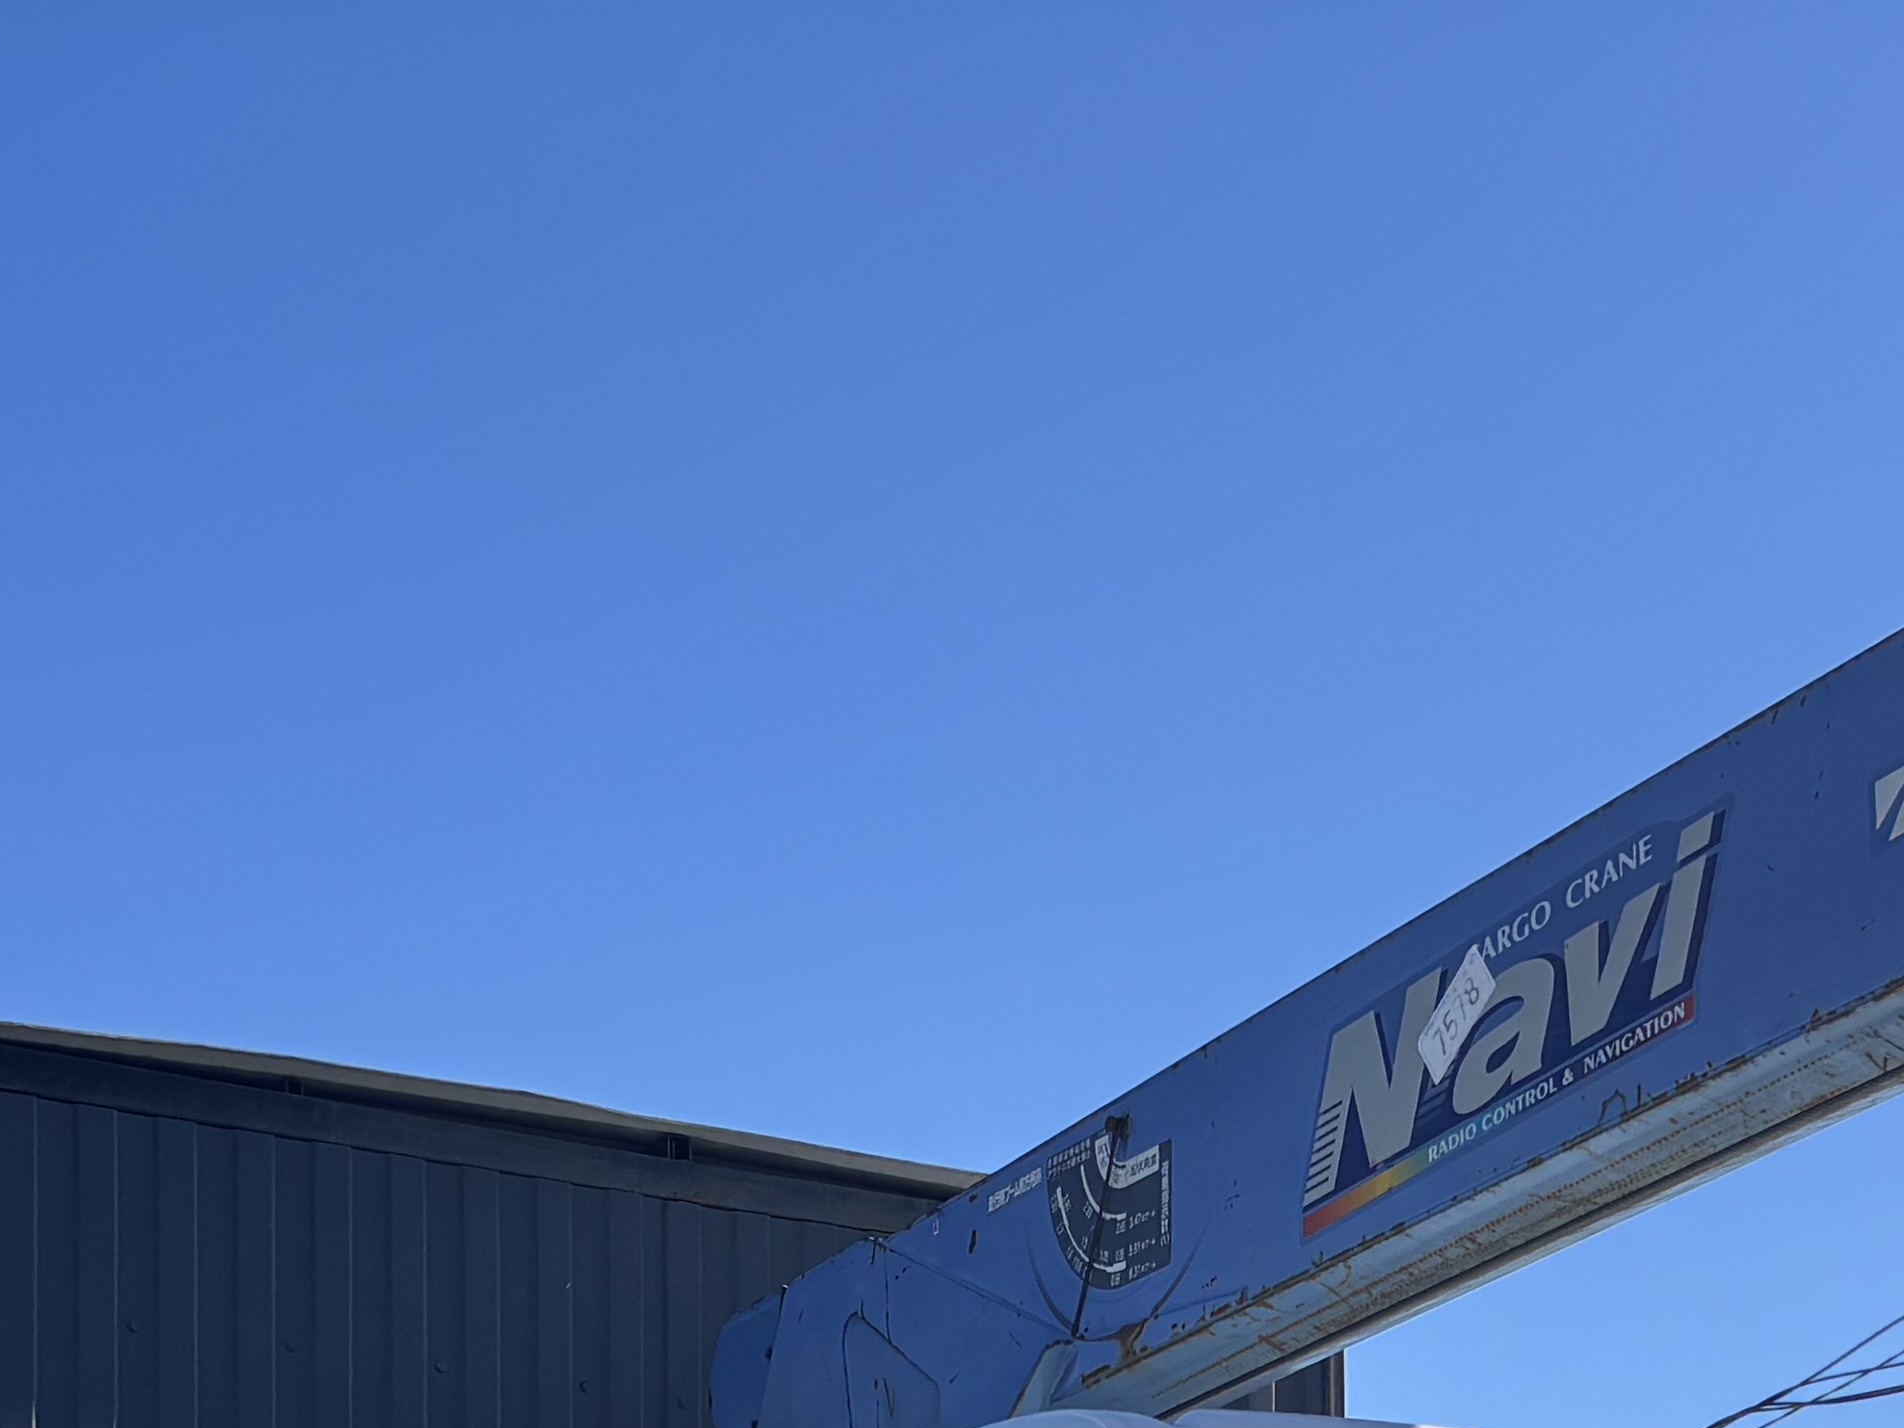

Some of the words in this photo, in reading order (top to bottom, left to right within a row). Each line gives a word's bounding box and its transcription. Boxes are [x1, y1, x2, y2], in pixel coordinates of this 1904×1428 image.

[1476, 900, 1552, 961] ARGO
[1565, 834, 1653, 909] CRANE
[1303, 811, 1721, 1208] Navi
[1427, 1123, 1477, 1163] RADIO
[1481, 1077, 1558, 1132] CONTROL
[1562, 1067, 1575, 1086] &
[1582, 1001, 1687, 1075] NAVIGATION
